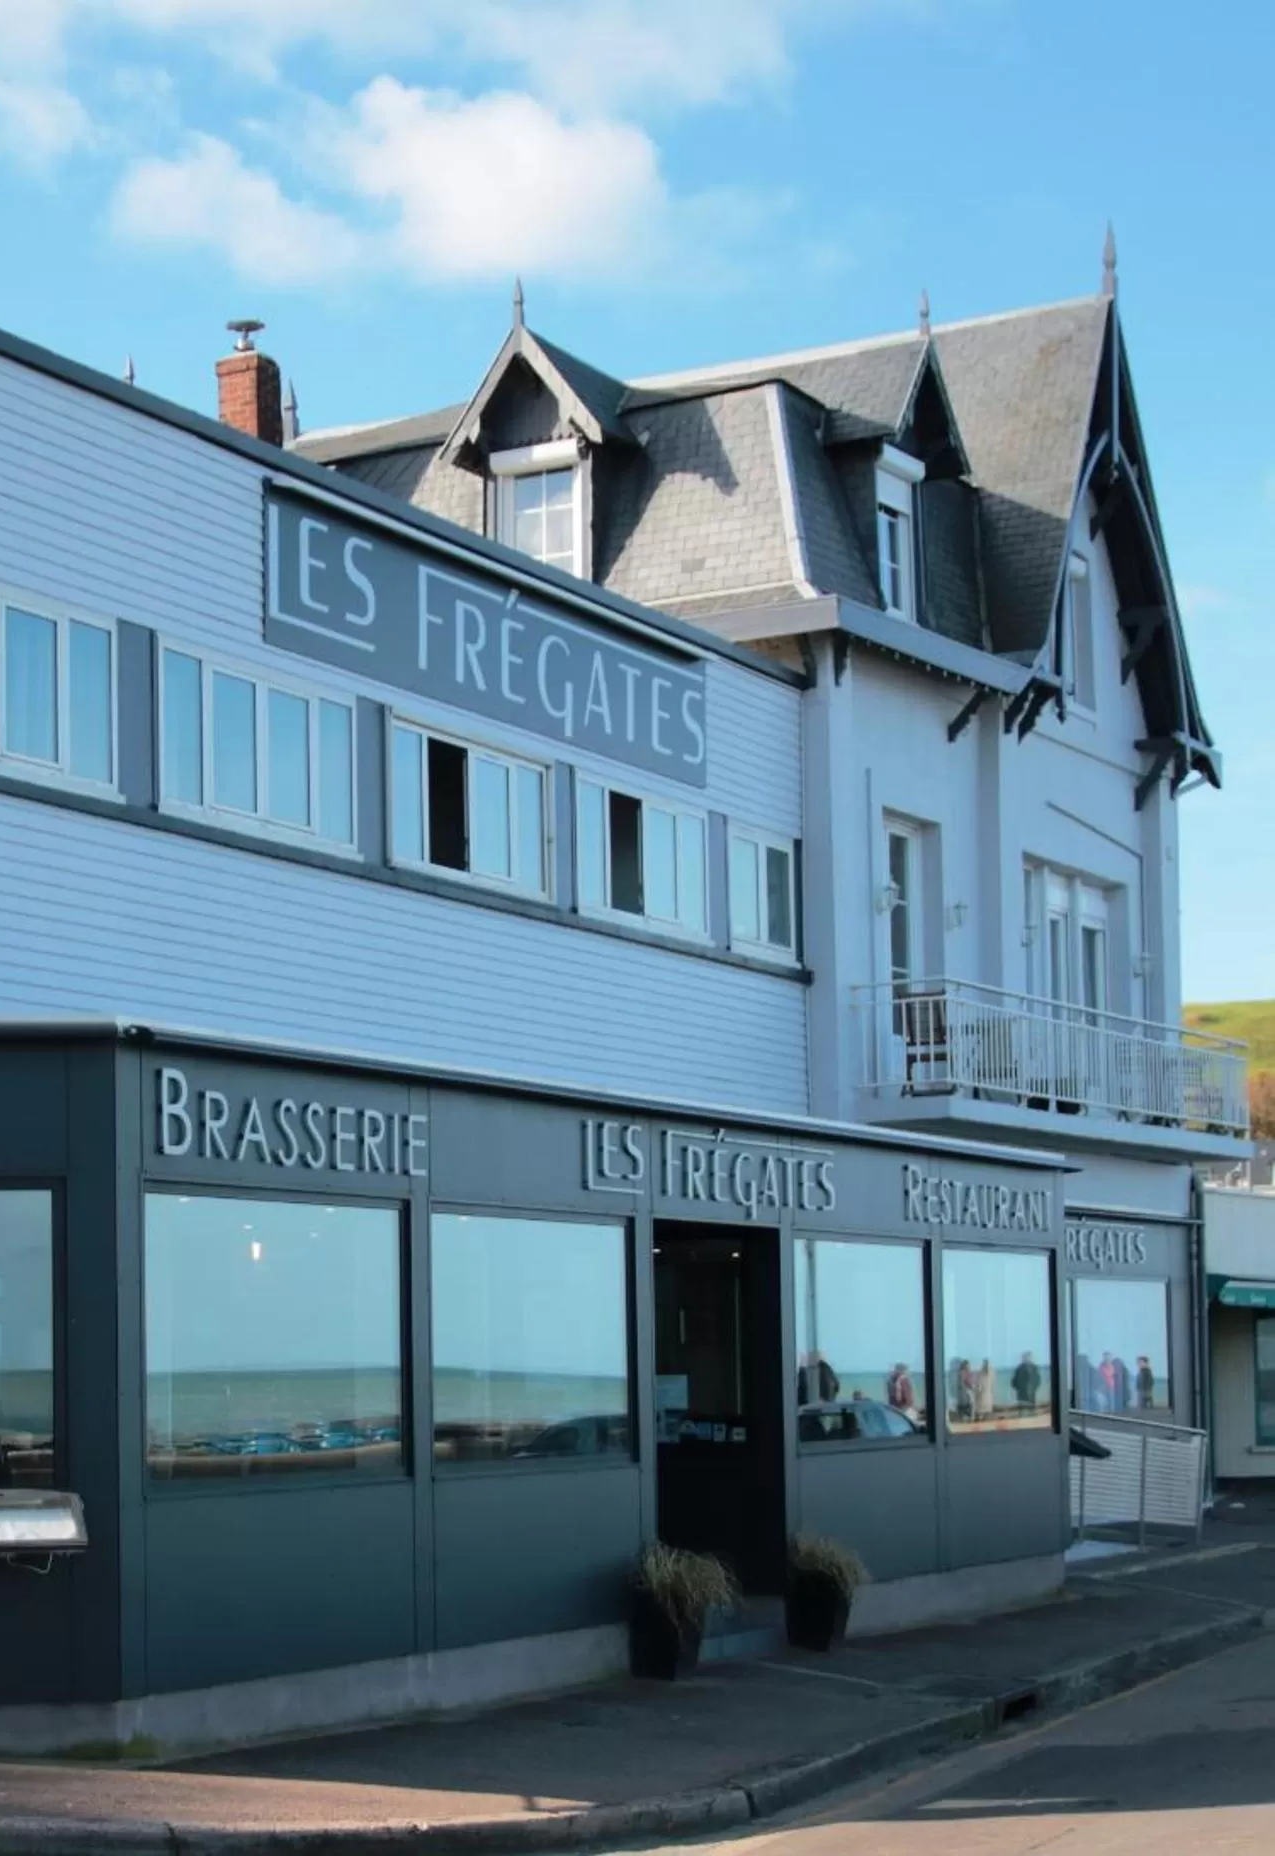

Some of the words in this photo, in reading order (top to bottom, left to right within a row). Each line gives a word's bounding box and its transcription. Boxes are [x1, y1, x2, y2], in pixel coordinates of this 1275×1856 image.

[268, 502, 376, 652] LES
[417, 564, 705, 765] FRÉGATES
[160, 1066, 427, 1177] BRASSERIE
[586, 1119, 644, 1194] LES
[665, 1127, 836, 1220] FRÉGATES
[908, 1163, 1052, 1233] RESTAURANT
[1065, 1216, 1146, 1270] RÉGATES
